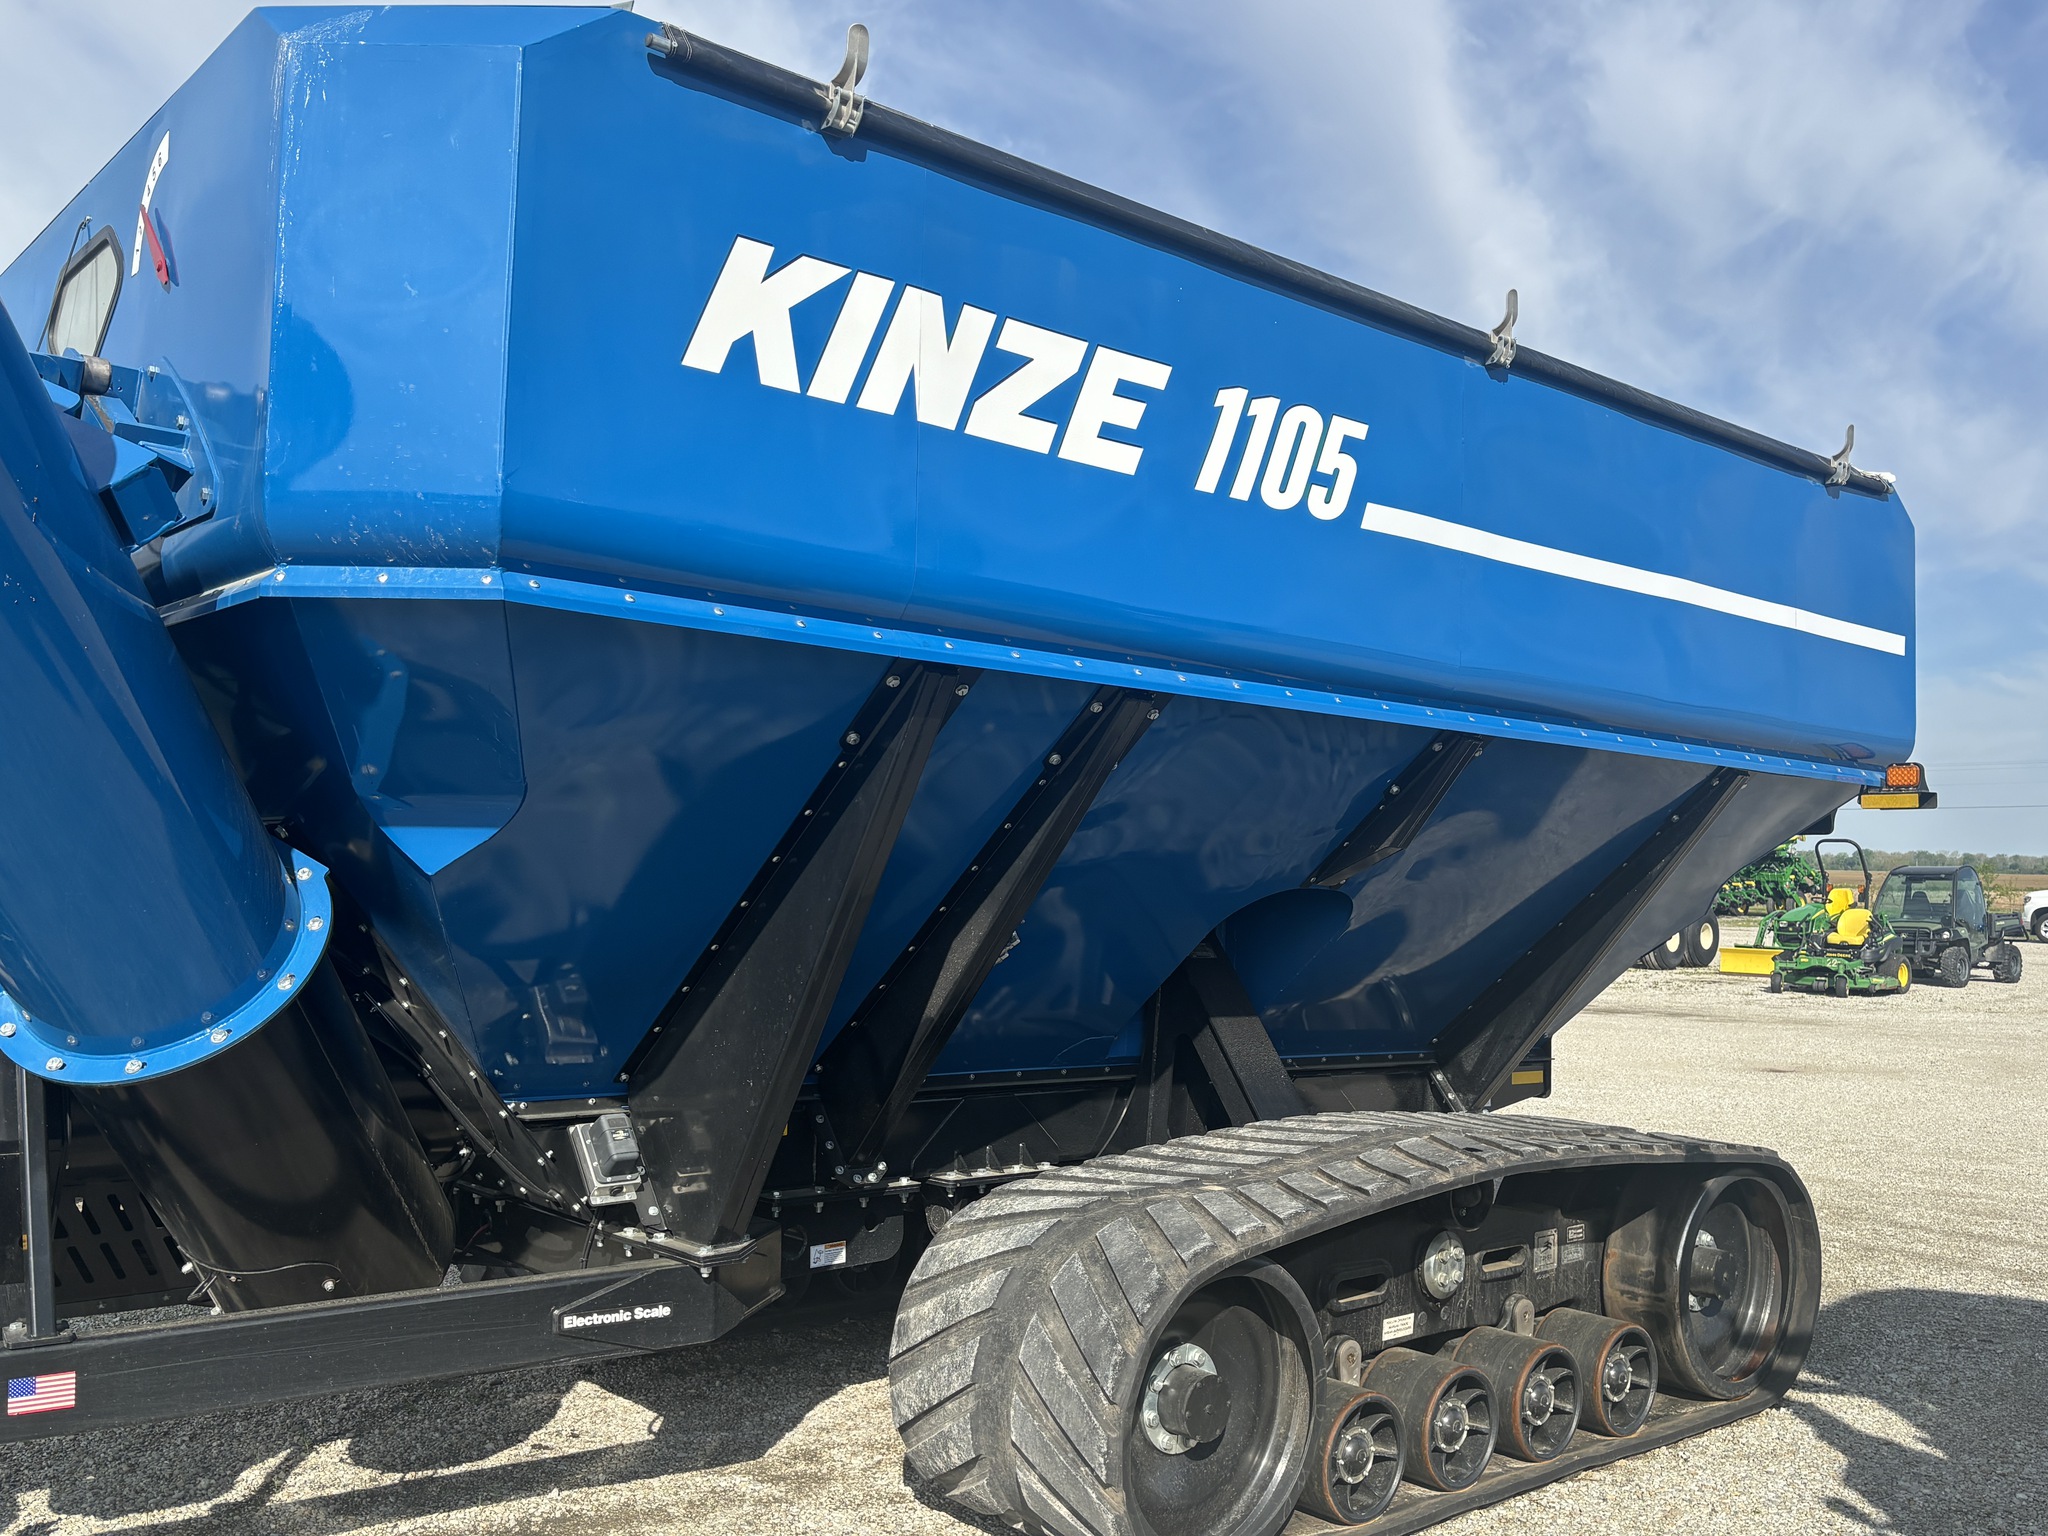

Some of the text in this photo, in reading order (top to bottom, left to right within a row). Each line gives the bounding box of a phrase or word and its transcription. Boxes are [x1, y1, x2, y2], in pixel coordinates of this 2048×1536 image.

[681, 233, 1370, 521] KINZE 1105
[563, 1304, 672, 1329] Electronic Scale
